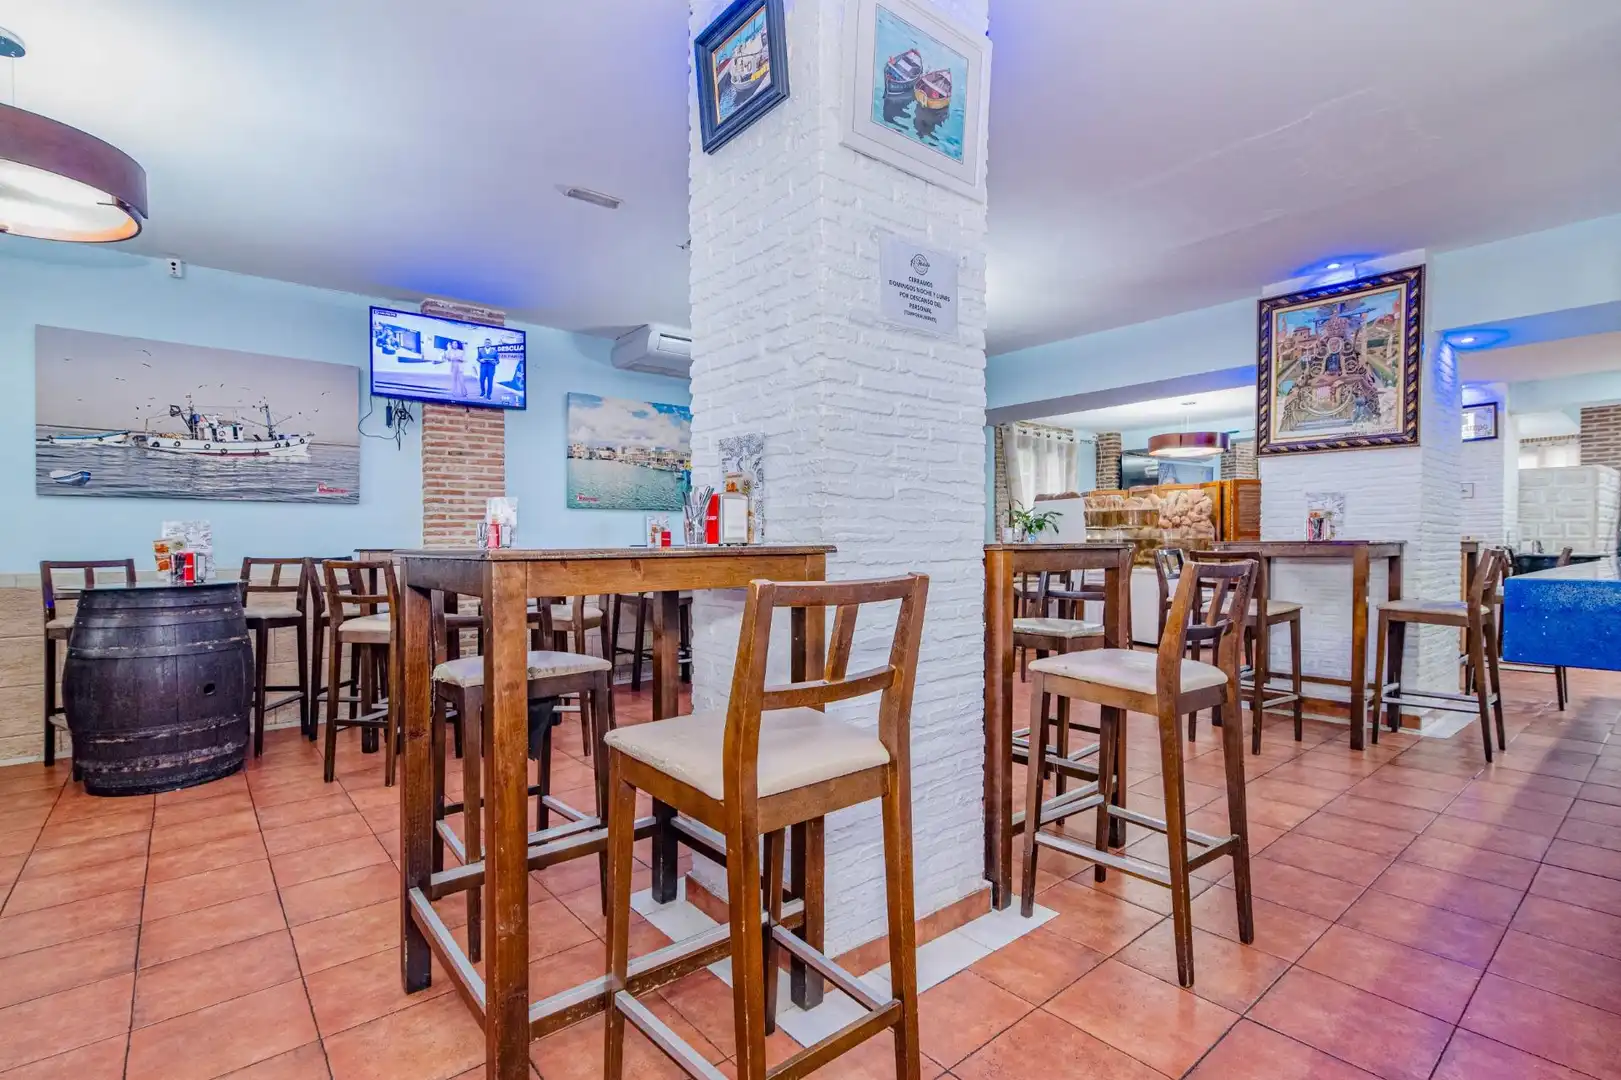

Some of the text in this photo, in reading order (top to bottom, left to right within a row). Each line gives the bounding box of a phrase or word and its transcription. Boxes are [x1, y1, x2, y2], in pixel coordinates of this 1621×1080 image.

[888, 279, 915, 292] DOMINGOS
[916, 287, 932, 297] NOCHE
[909, 276, 933, 288] CERRAMOS
[899, 291, 942, 309] POR DESCANSO DEL
[909, 302, 932, 314] PERSONAL
